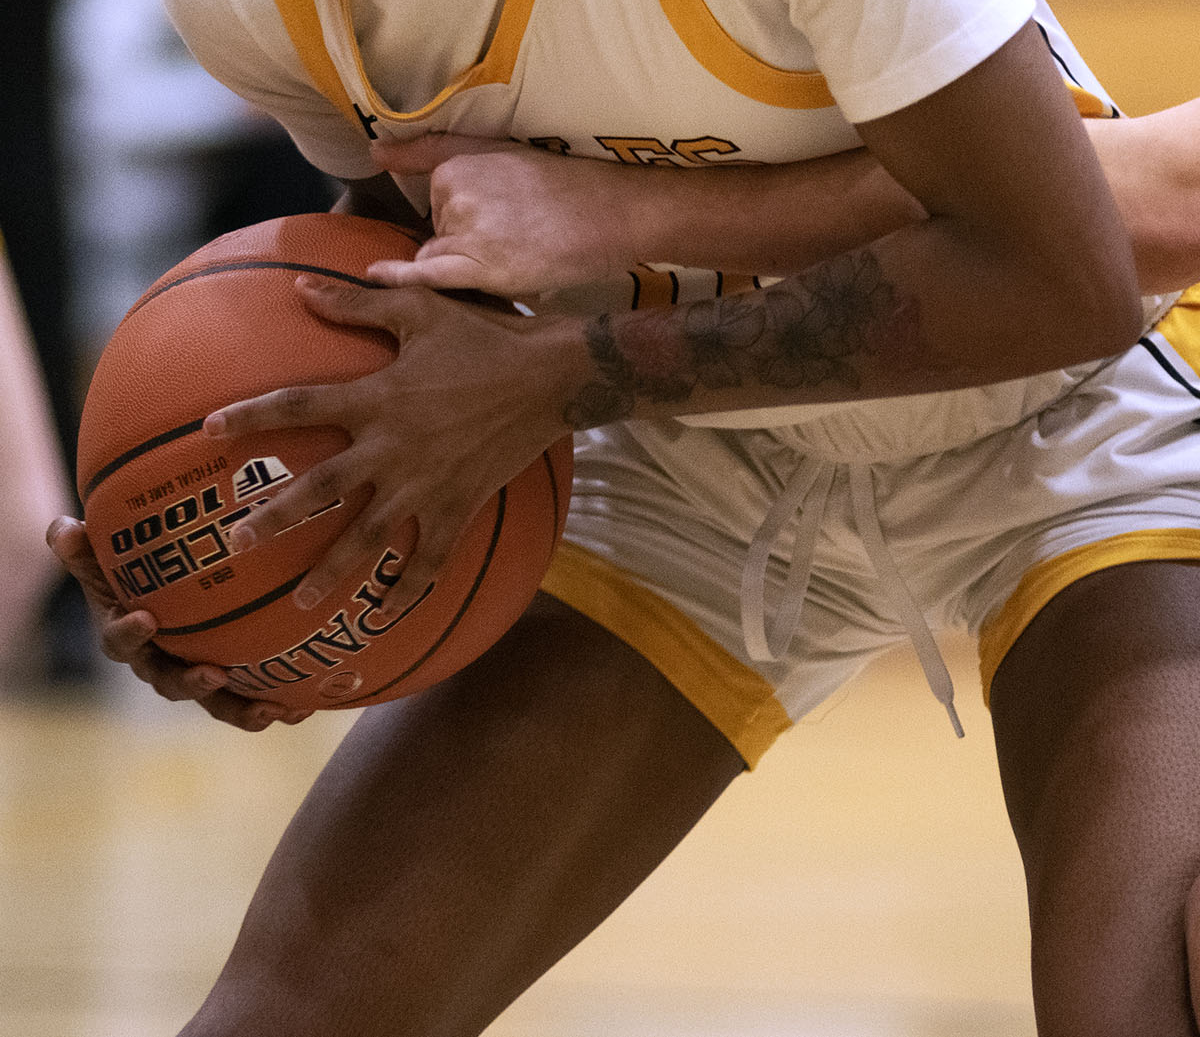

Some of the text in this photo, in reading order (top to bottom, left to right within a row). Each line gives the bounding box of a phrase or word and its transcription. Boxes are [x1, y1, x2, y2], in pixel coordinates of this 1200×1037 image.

[111, 460, 290, 555] TF 1000
[125, 456, 227, 513] OFFICIAL GAME BALL
